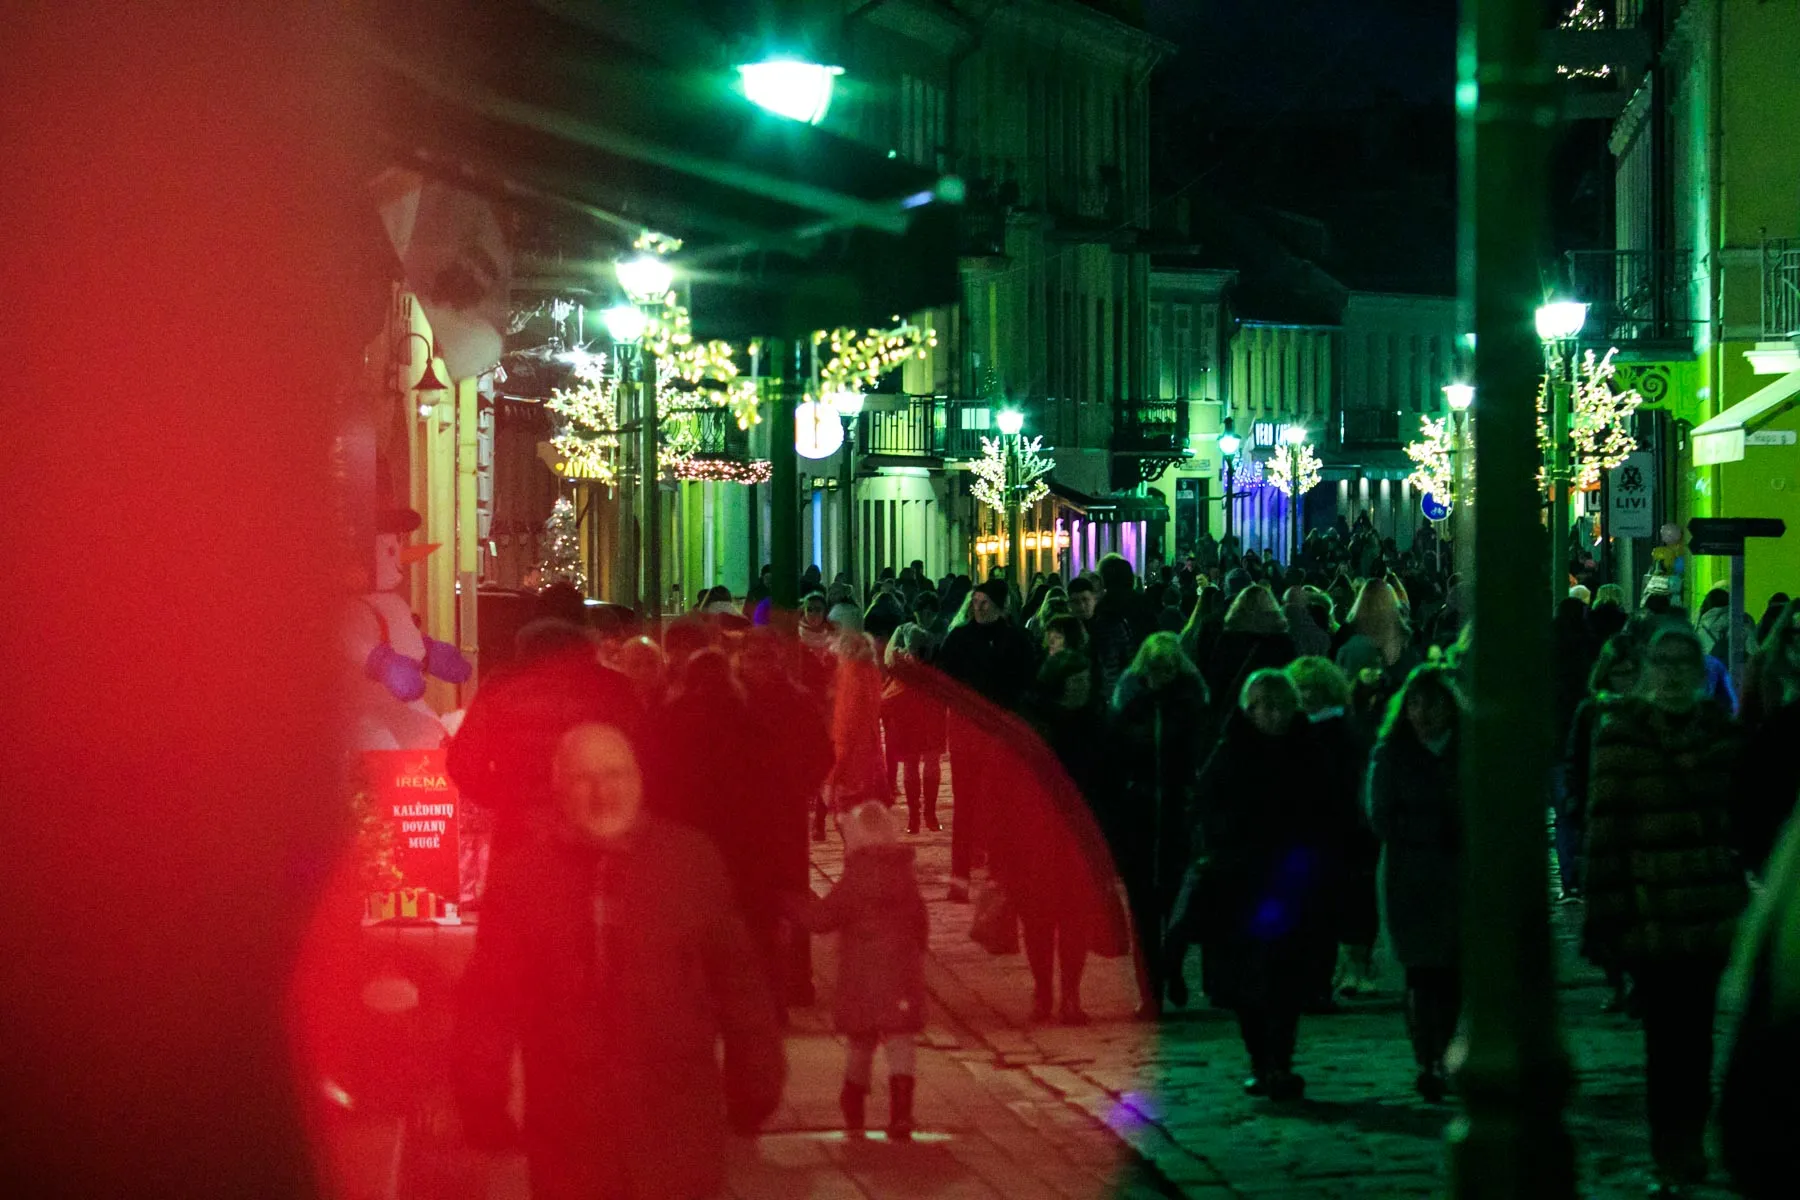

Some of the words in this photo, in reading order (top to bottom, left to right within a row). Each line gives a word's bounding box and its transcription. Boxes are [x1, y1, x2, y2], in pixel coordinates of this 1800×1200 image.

[1616, 498, 1646, 508] LIVI
[397, 776, 447, 787] IRENA
[394, 802, 453, 818] KALĖDINIŲ
[402, 821, 445, 835] DOVANŲ
[409, 835, 440, 849] MUGĖ
